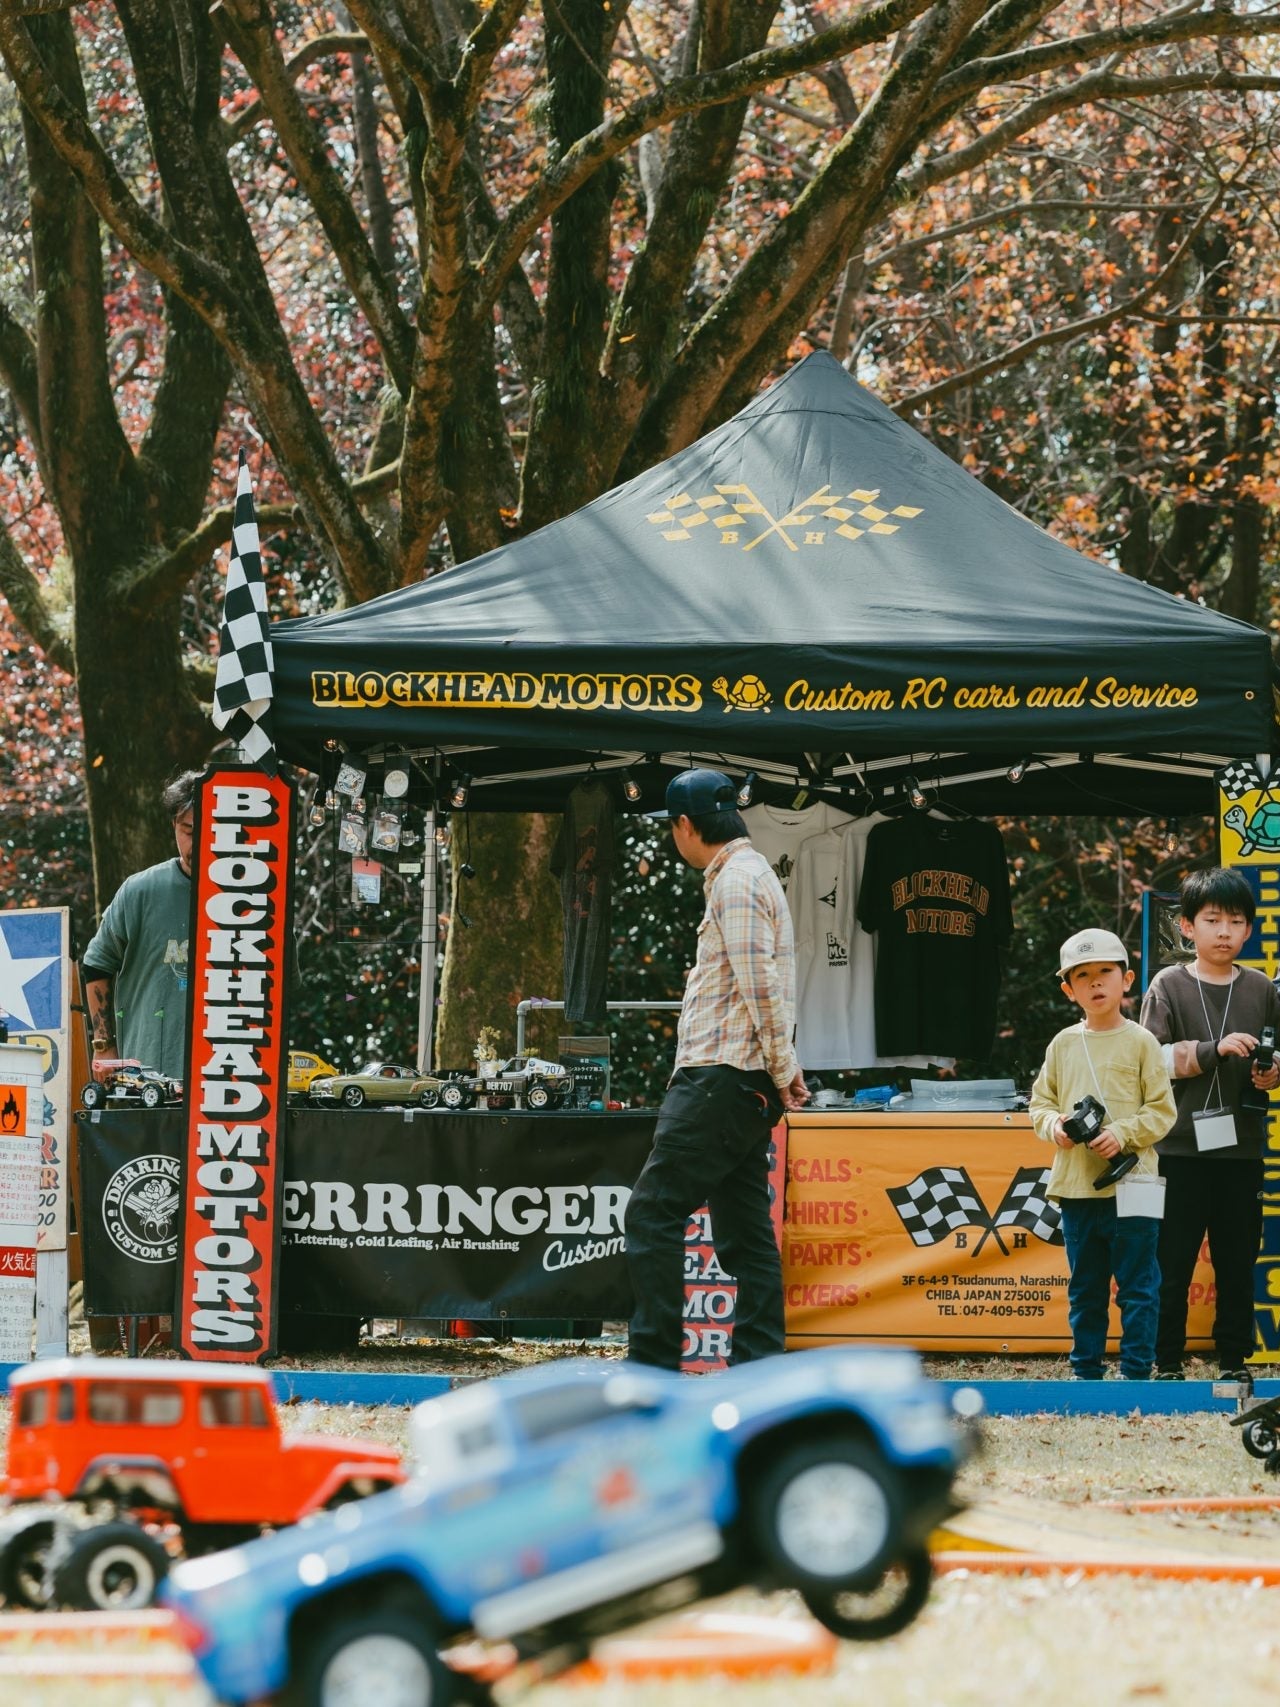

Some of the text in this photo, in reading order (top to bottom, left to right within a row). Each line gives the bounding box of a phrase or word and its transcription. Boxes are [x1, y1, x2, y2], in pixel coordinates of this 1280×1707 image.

[719, 531, 826, 545] B H
[783, 679, 895, 712] Custom
[900, 677, 948, 709] RC
[953, 683, 1020, 708] cars
[1025, 677, 1089, 708] and
[1089, 676, 1199, 708] Service
[544, 1065, 561, 1075] 707
[107, 1158, 181, 1205] DERRIN
[283, 1180, 635, 1236] ERRINGER
[110, 1221, 163, 1259] CUSTOM
[355, 1235, 386, 1247] Gold
[441, 1237, 461, 1249] Air
[463, 1239, 520, 1252] Brushing
[955, 1232, 1028, 1249] B H
[542, 1236, 627, 1272] Custom
[789, 1242, 862, 1266] PARTS
[902, 1275, 916, 1286] 3F
[918, 1275, 949, 1286] 6-4-9
[952, 1275, 1018, 1288] Tsudanuma,
[926, 1290, 1051, 1301] CHIBA JAPAN 2750016
